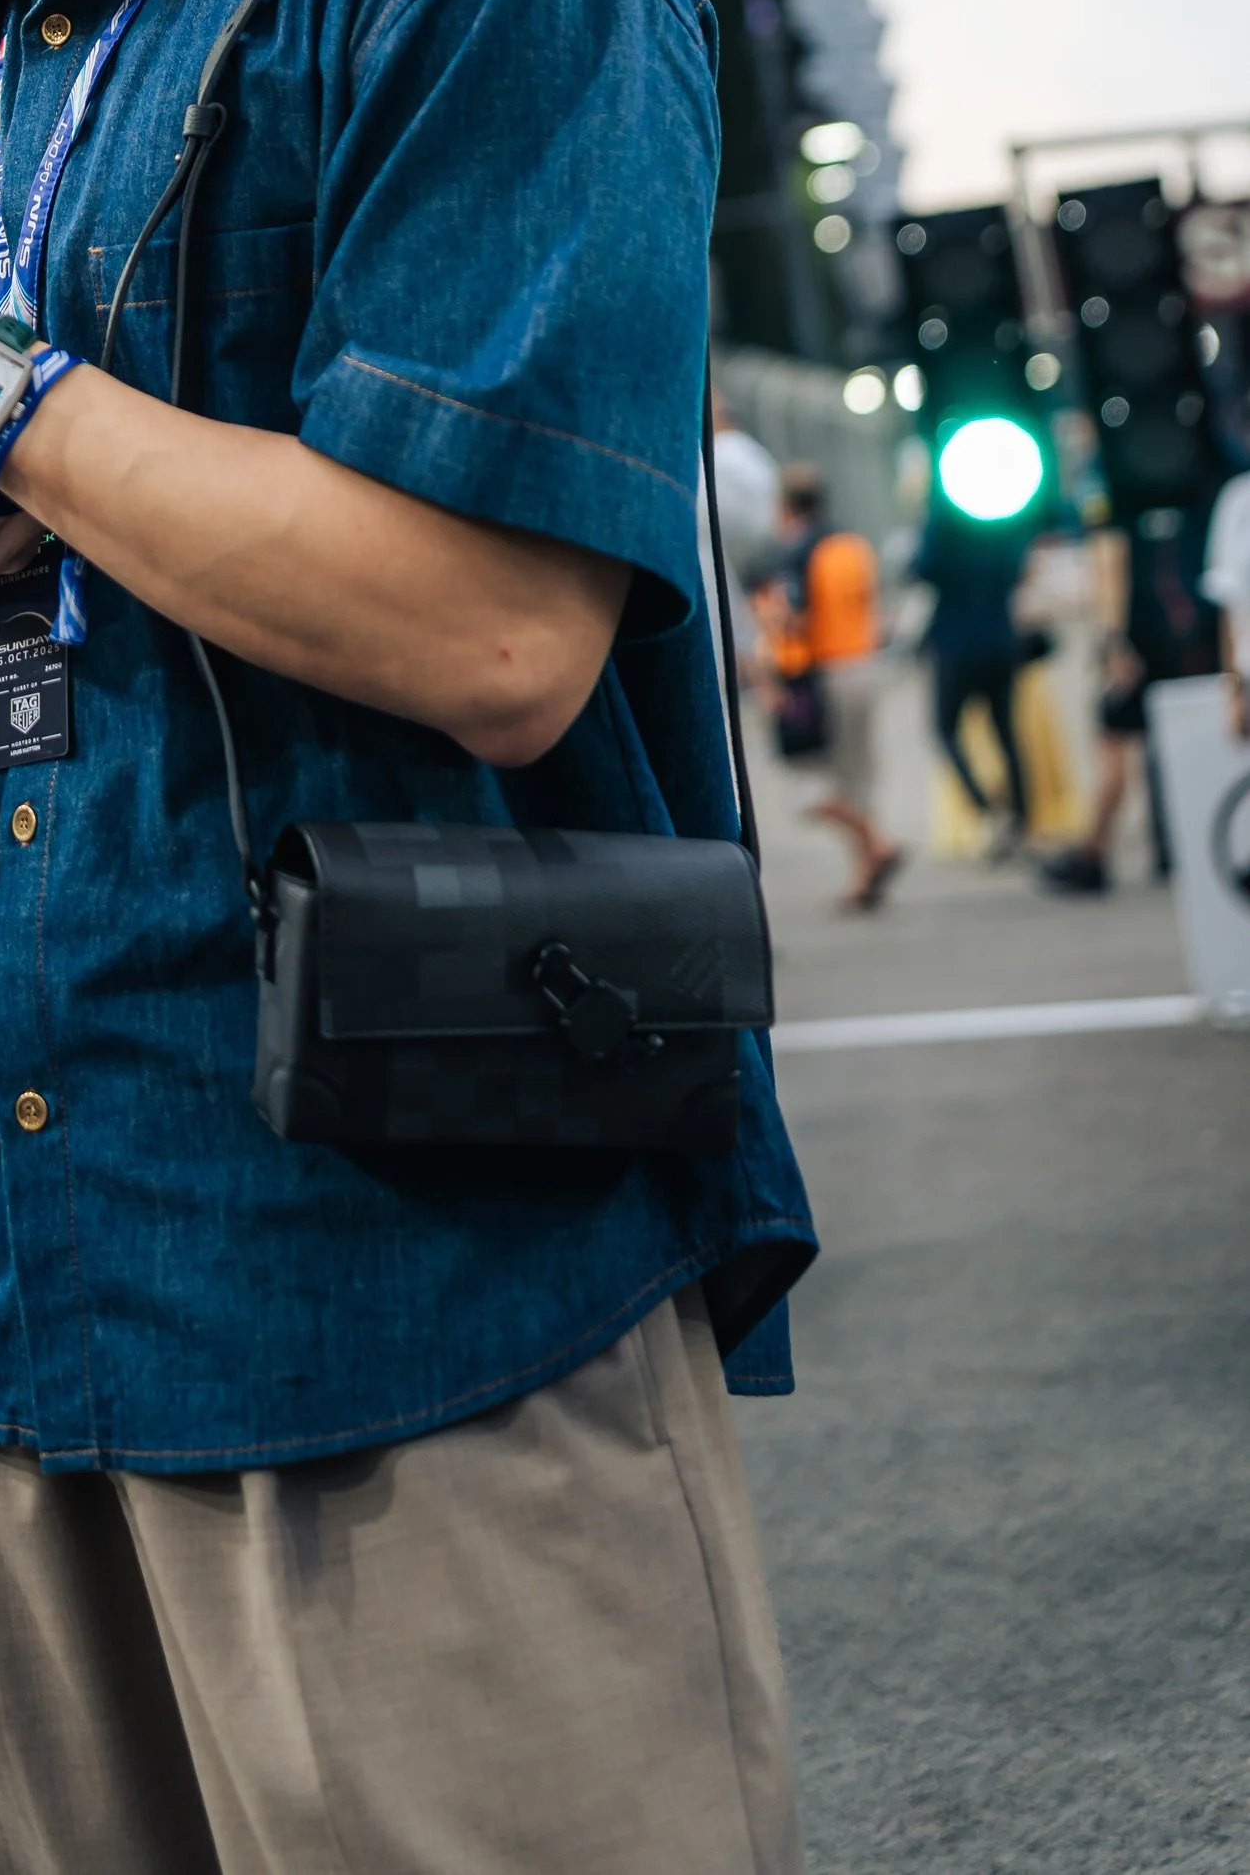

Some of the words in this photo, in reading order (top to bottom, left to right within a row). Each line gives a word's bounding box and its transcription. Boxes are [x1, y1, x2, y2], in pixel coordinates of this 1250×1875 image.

[19, 194, 42, 269] SUN
[39, 159, 53, 183] 05
[49, 117, 68, 159] OCT
[13, 695, 38, 712] TAG
[12, 708, 39, 730] HEUER
[11, 738, 32, 748] HOSTED
